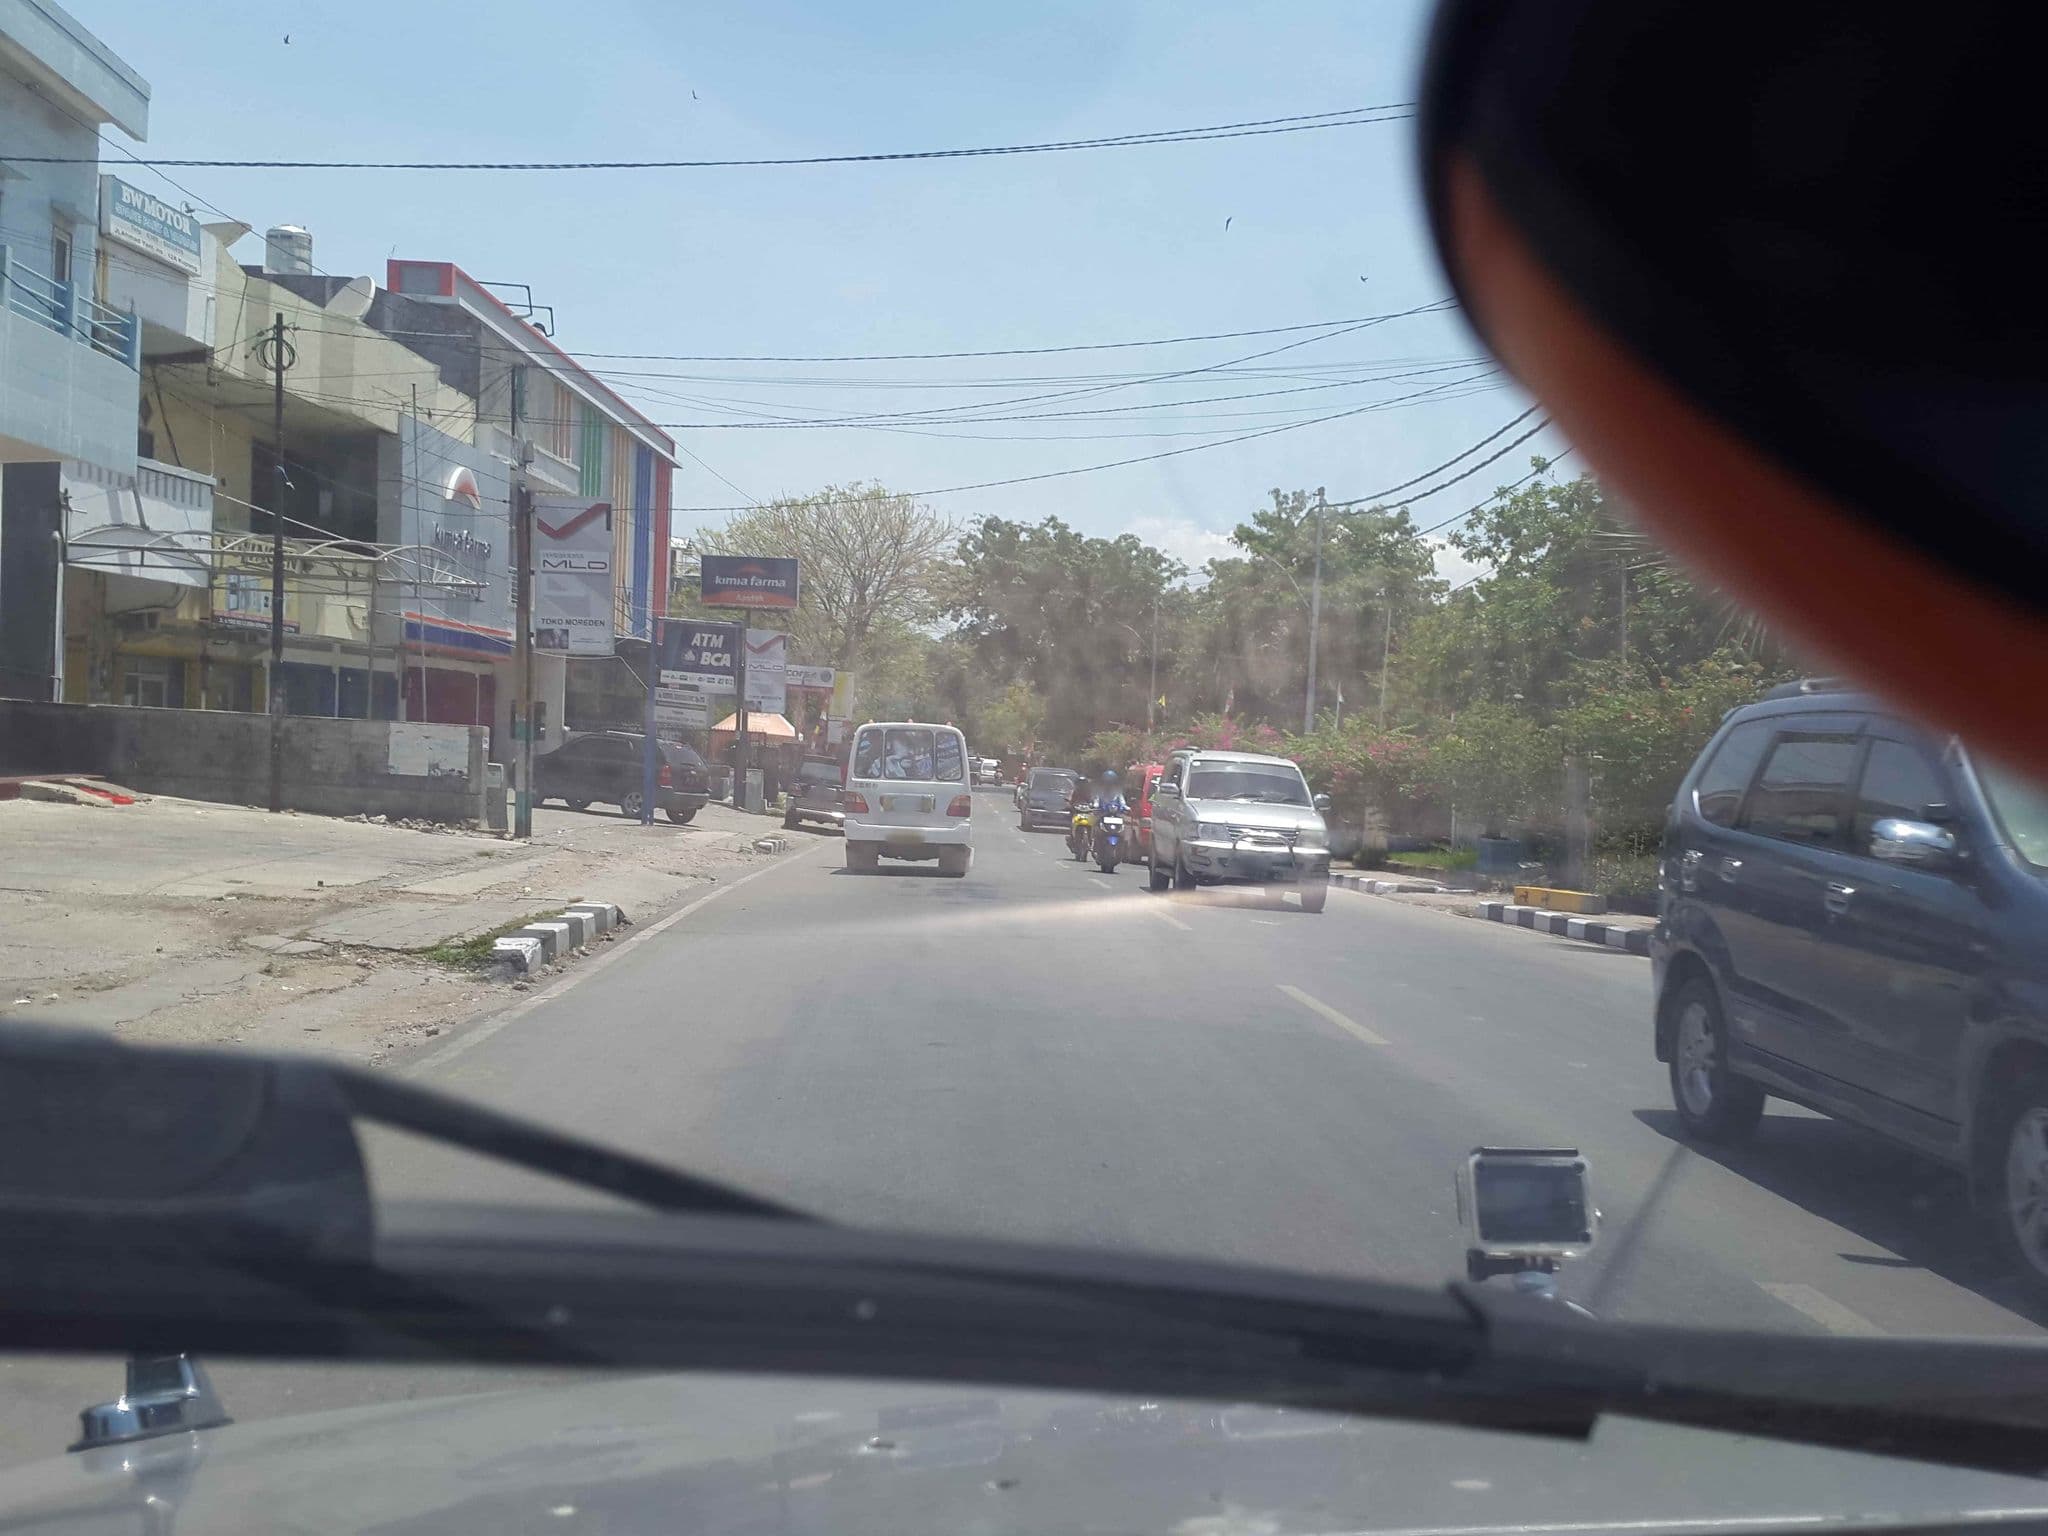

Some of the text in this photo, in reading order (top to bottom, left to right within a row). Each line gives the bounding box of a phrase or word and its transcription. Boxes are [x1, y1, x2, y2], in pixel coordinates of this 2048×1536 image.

[144, 196, 192, 237] MOTOR
[715, 575, 787, 587] kimia farma
[541, 618, 563, 626] TOKO
[691, 633, 724, 648] ATM
[701, 651, 731, 667] BCA
